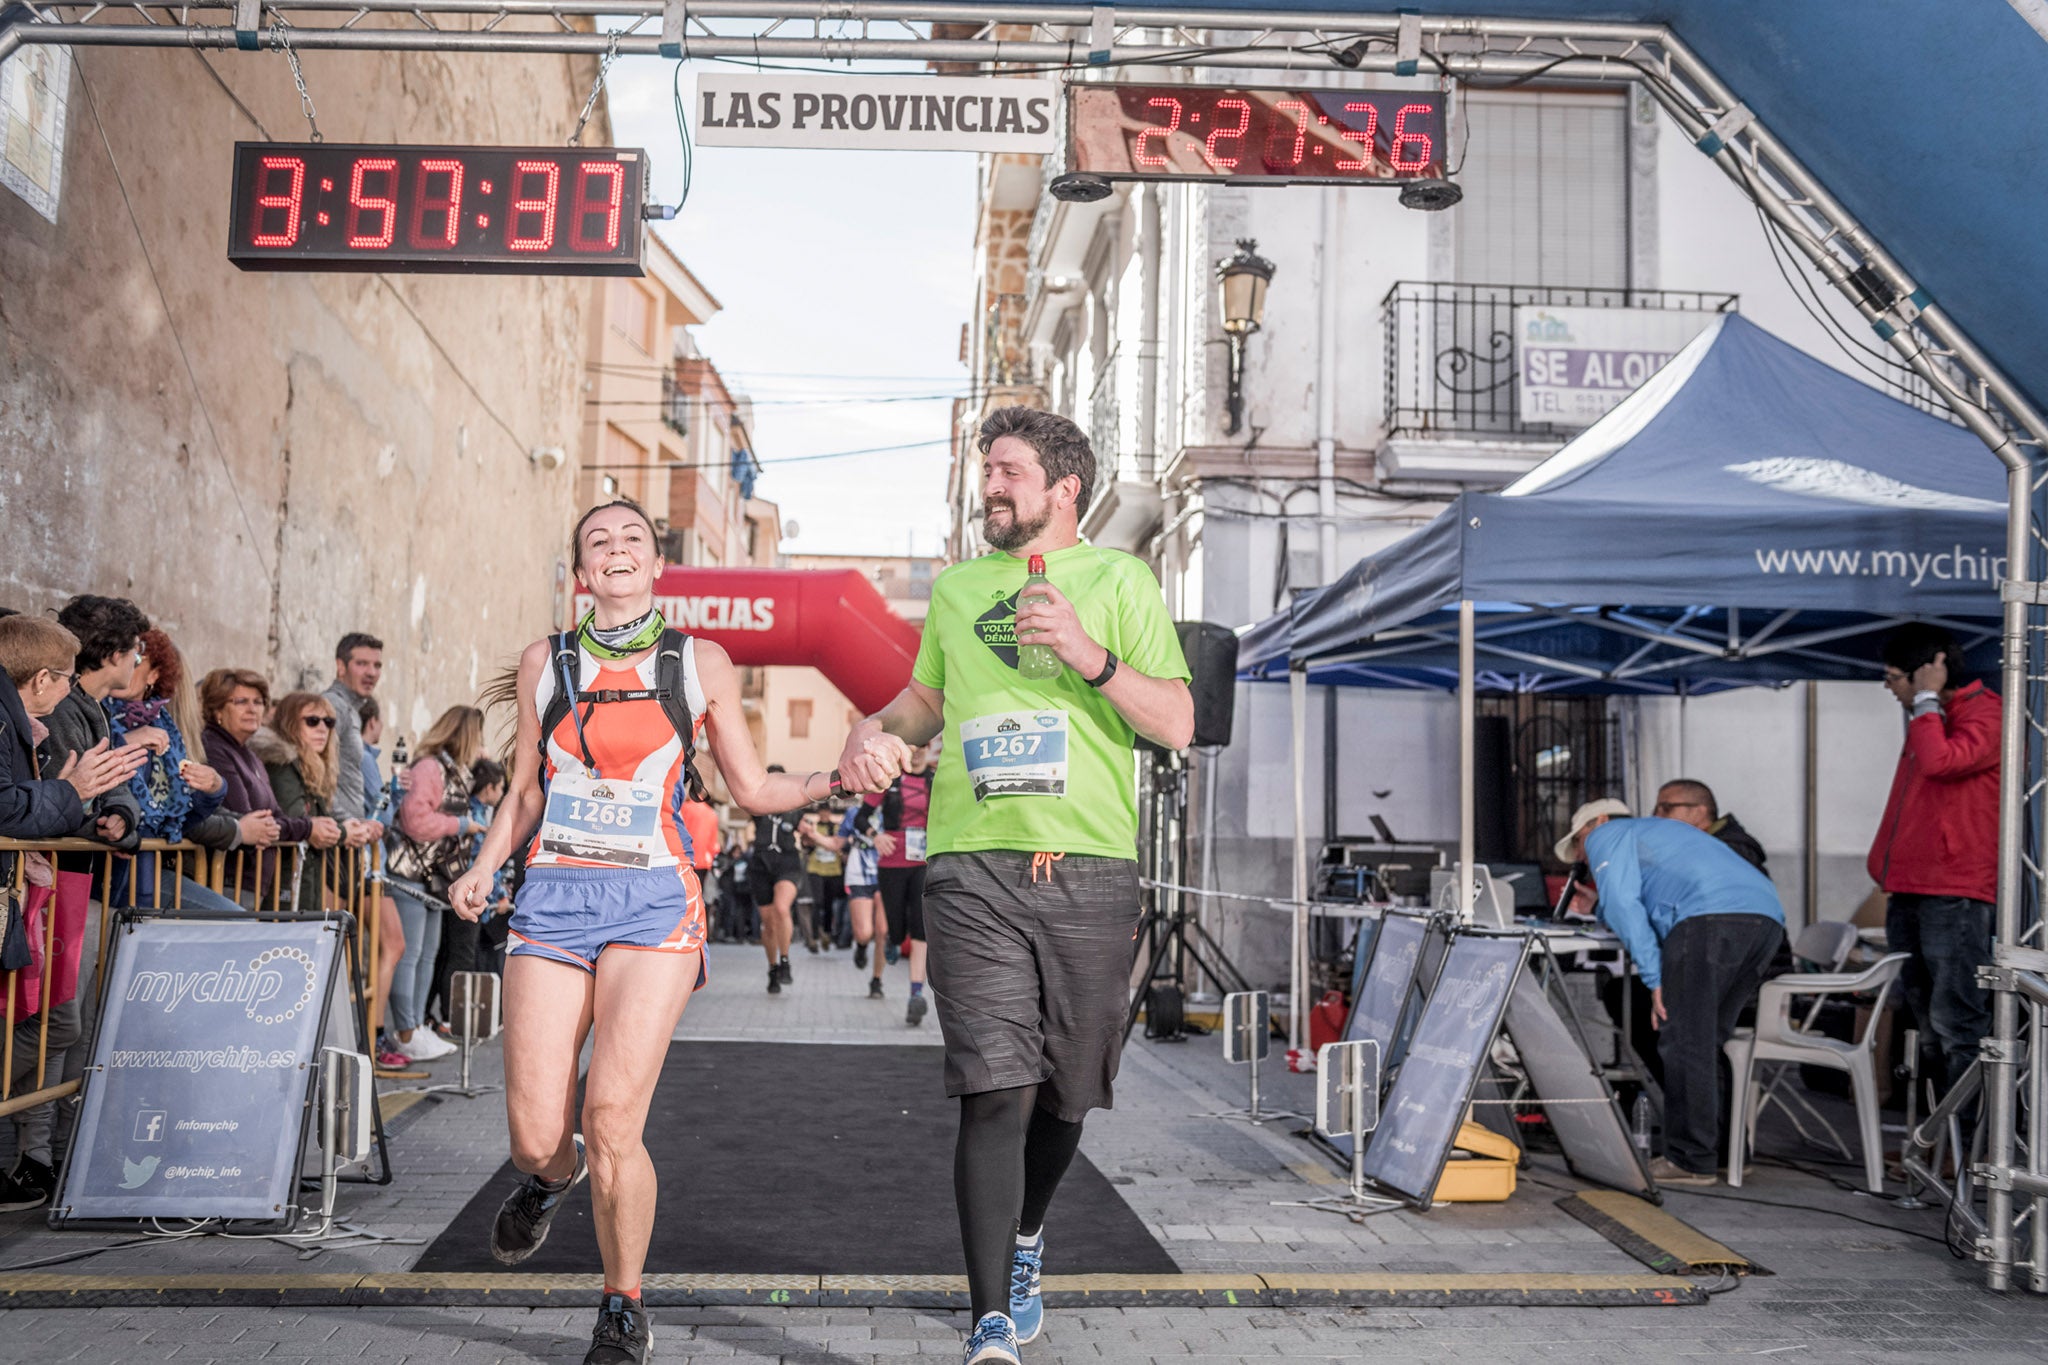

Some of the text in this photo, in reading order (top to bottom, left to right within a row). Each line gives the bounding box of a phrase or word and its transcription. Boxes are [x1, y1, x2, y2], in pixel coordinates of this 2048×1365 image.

[702, 91, 1051, 136] LAS PROVINCIAS
[1135, 97, 1433, 173] 2:27:36
[250, 156, 625, 253] 3:57:37
[1528, 350, 1569, 386] SE
[575, 594, 775, 632] PINCIAS
[982, 624, 1015, 633] VOLTA
[984, 633, 1018, 643] DÉNIA
[979, 735, 1042, 759] 1267
[569, 799, 632, 827] 1268
[126, 959, 283, 1013] mychip
[110, 1045, 295, 1074] www.mychip.es
[175, 1119, 239, 1132] /infomychip
[164, 1165, 242, 1180] @Mychip_Info
